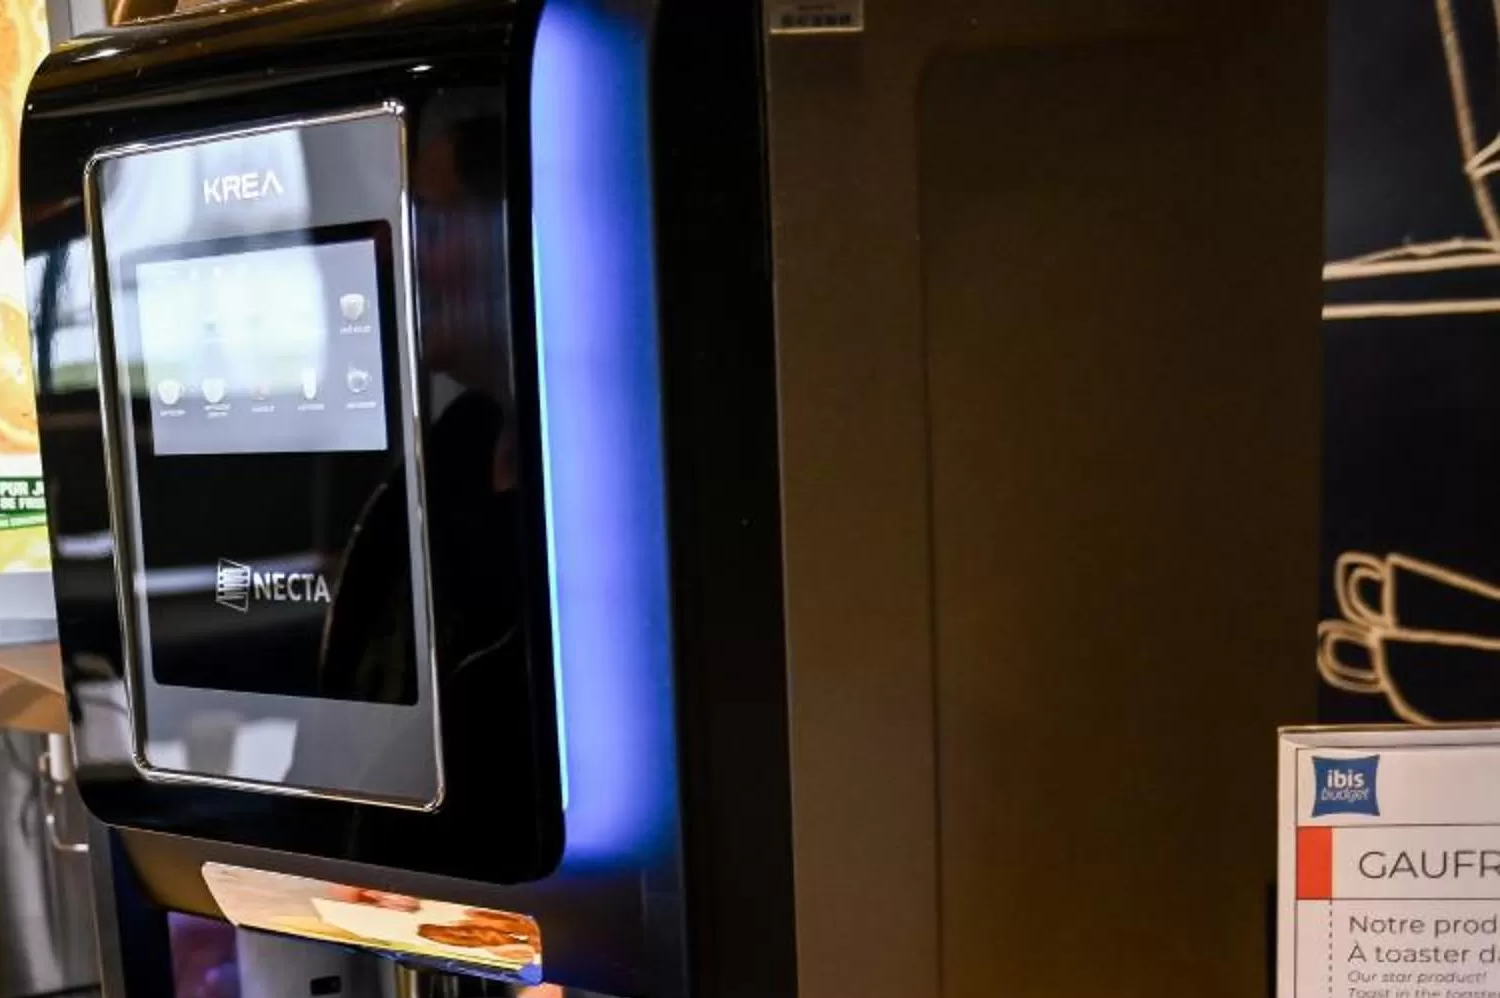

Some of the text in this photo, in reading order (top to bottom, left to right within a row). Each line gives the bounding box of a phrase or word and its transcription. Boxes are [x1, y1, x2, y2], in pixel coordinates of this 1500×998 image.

[203, 168, 284, 204] KREA
[253, 571, 331, 602] NECTA
[1327, 769, 1365, 787] ibis
[1321, 786, 1370, 803] budget
[1349, 913, 1498, 938] Notre prod
[1348, 939, 1367, 963] À
[1375, 946, 1471, 963] toaster
[1348, 970, 1378, 983] Our
[1381, 971, 1412, 983] star
